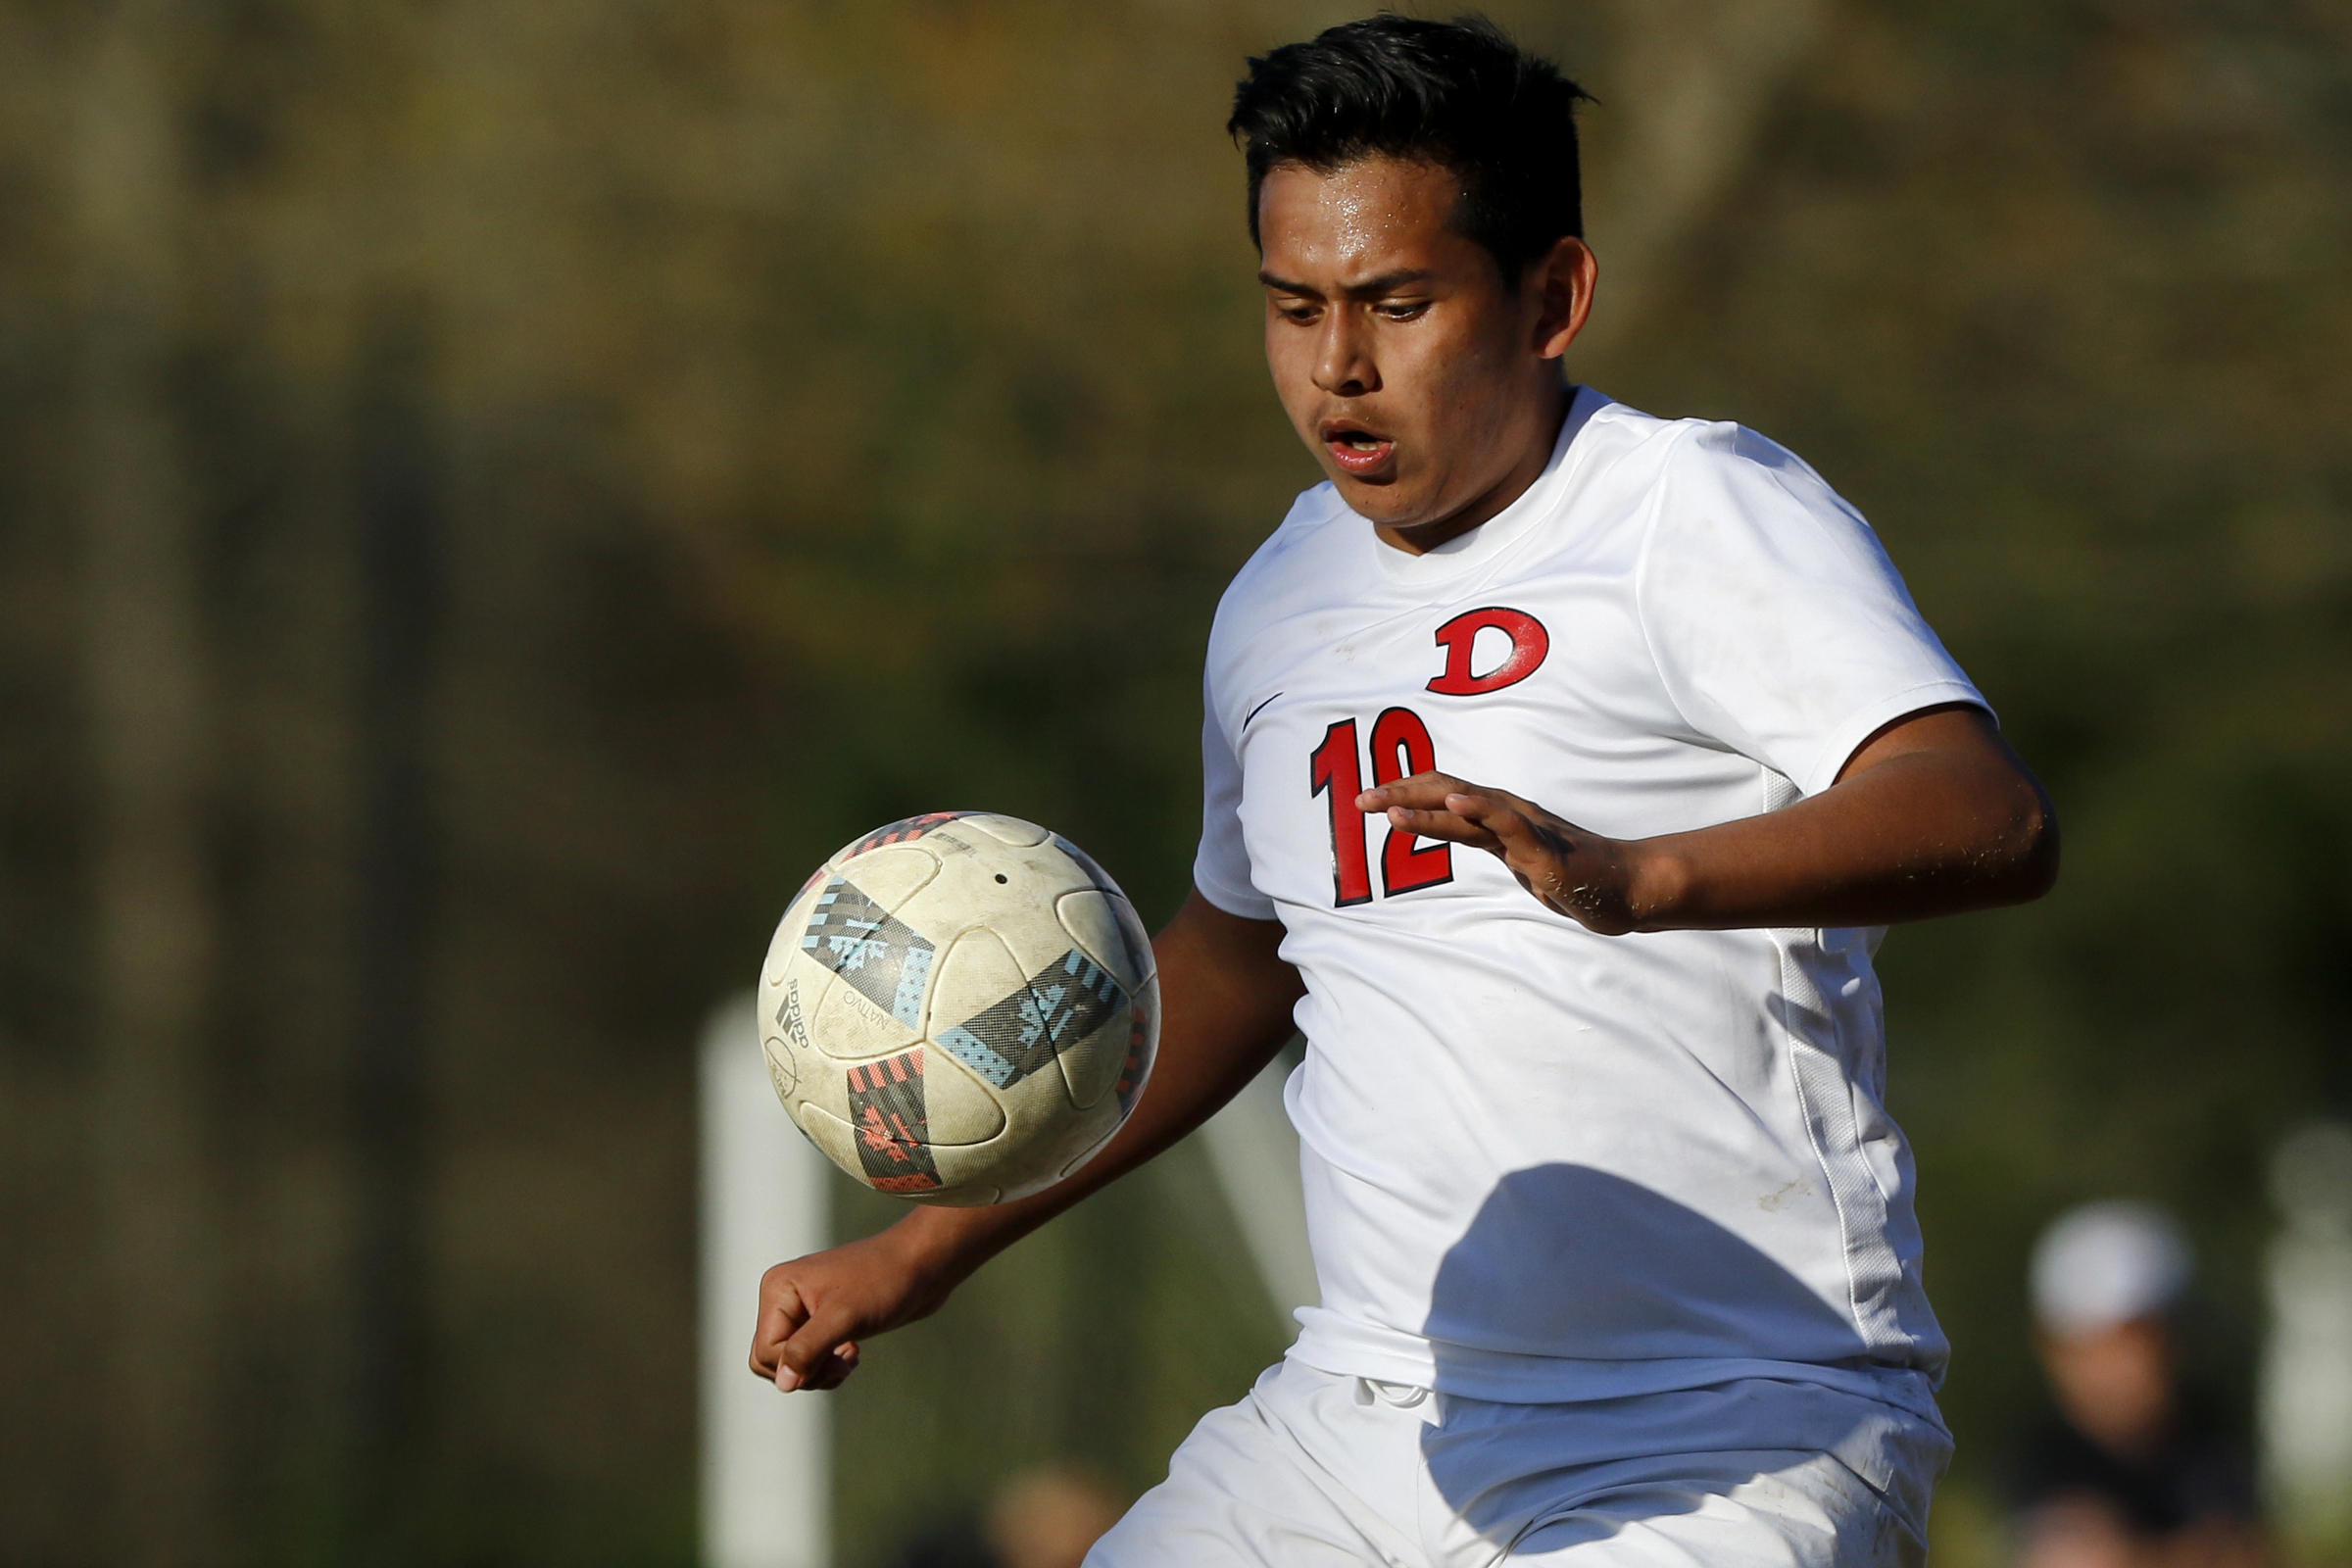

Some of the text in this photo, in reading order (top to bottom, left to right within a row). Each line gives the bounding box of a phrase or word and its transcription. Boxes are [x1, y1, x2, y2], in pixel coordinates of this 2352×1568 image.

[1425, 606, 1550, 697] D
[1310, 707, 1454, 908] 12
[787, 978, 808, 1049] adidas
[843, 990, 890, 1031] NATIVO
